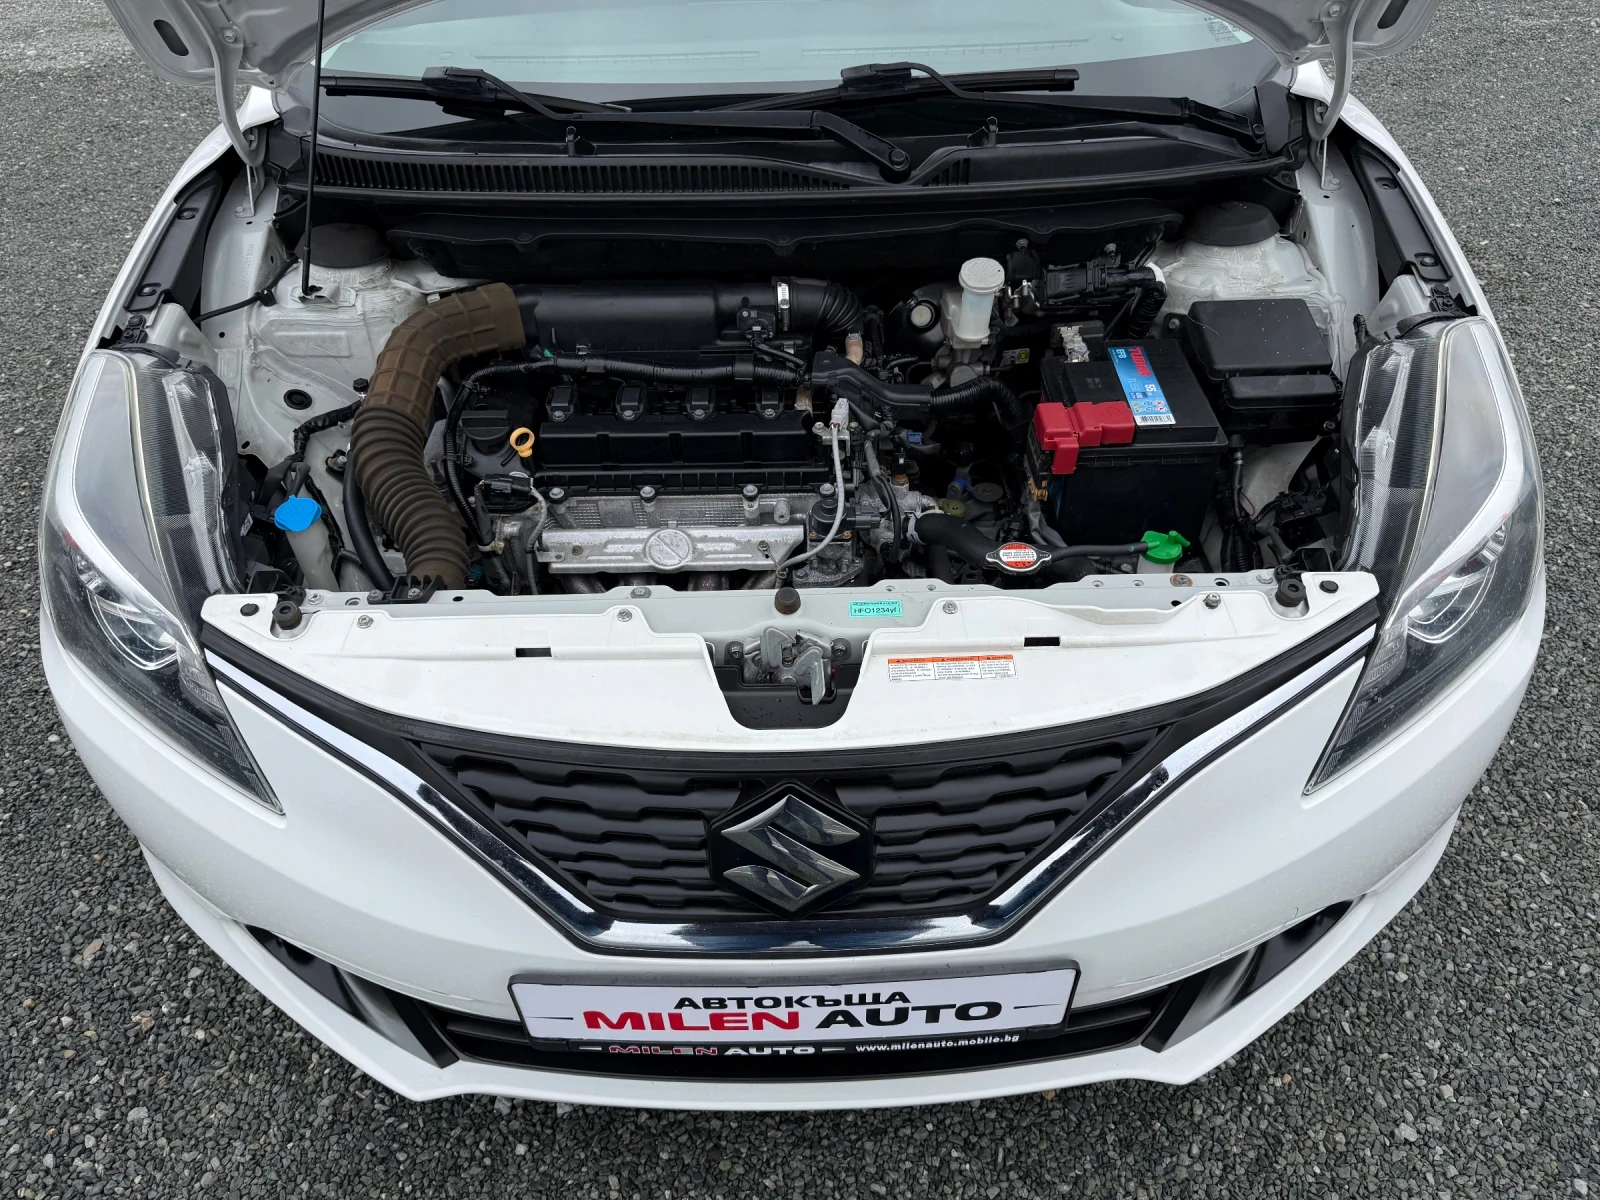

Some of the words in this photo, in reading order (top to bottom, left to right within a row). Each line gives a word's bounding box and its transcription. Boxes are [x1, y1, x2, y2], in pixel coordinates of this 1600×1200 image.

[1116, 349, 1127, 358] EFB
[1144, 384, 1157, 392] 55
[583, 1010, 799, 1030] MILEN
[815, 1001, 1002, 1029] AUTO
[608, 1045, 718, 1056] MILEN
[723, 1045, 816, 1056] AUTO
[856, 1034, 1020, 1052] www.milenauto.mobile.bg
